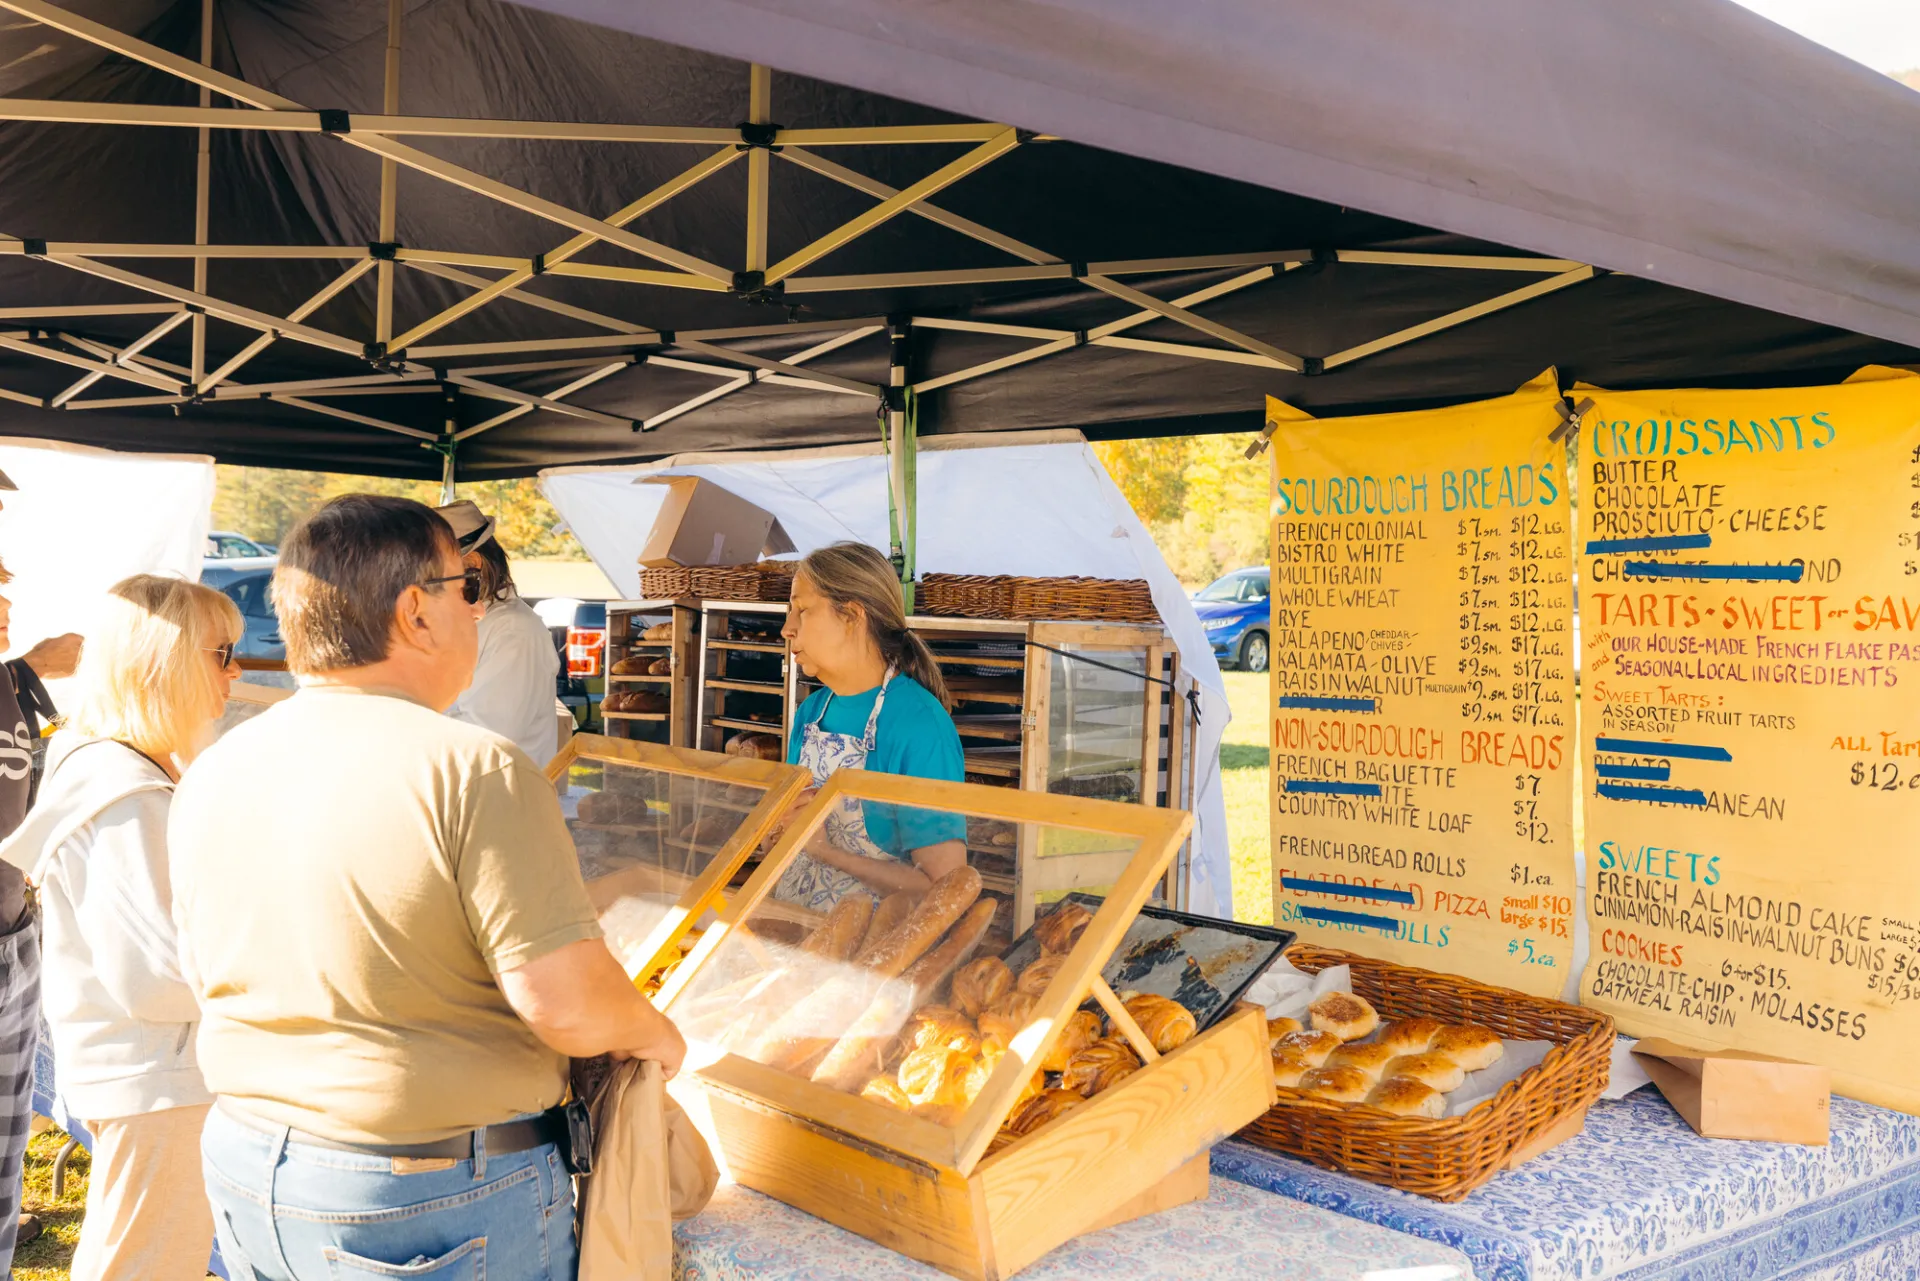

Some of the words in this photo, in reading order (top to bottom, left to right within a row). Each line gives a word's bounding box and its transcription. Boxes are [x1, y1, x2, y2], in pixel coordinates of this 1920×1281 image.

[1593, 412, 1836, 457] CROISSANTS
[1592, 460, 1678, 485] BUTTER
[1276, 473, 1428, 516] SOURDOUGH
[1441, 462, 1558, 512] BREADS
[1594, 484, 1726, 509] CHOCOLATE
[1278, 522, 1341, 542] FRENCH
[1346, 520, 1428, 541] COLONIAL
[1278, 543, 1337, 563] BISTRO
[1346, 543, 1405, 563] WHITE
[1278, 565, 1382, 585] MULTIGRAIN
[1279, 587, 1336, 607] WHOLE
[1339, 588, 1401, 608] WHEAT
[1278, 609, 1312, 628] RYE
[1591, 593, 1701, 628] TARTS
[1722, 595, 1828, 631] SWEET
[1587, 629, 1611, 649] with
[1611, 636, 1642, 653] OUR
[1647, 633, 1748, 656] HOUSE-MADE
[1756, 635, 1819, 659] FRENCH
[1825, 641, 1884, 661] FLAKE
[1278, 650, 1367, 672] KALAMATA
[1381, 655, 1437, 676] OLIVE
[1591, 651, 1610, 672] and
[1614, 654, 1695, 679] SEASONAL
[1697, 657, 1748, 682] LOCAL
[1752, 663, 1898, 688] INGREDIENTS
[1278, 670, 1341, 691] RAISIN
[1345, 673, 1426, 696] WALNUT
[1424, 684, 1467, 694] MULTIGRAIN
[1593, 680, 1653, 704] SWEET
[1602, 704, 1691, 723] ASSORTED
[1697, 710, 1743, 726] FRUIT
[1749, 713, 1796, 730] TARTS
[1603, 717, 1615, 729] IN
[1620, 719, 1675, 733] SEASON
[1275, 718, 1444, 761] NON-SOURDOUGH
[1461, 730, 1564, 770] BREADS
[1830, 736, 1872, 752] ALL
[1277, 754, 1347, 778] FRENCH
[1355, 760, 1457, 788] BAGUETTE
[1278, 794, 1359, 821] COUNTRY
[1363, 802, 1420, 828] WHITE
[1428, 810, 1472, 834] LOAF
[1515, 821, 1554, 844] $12.
[1280, 835, 1344, 861] FRENCH
[1348, 843, 1407, 869] BREAD
[1412, 851, 1466, 878] ROLLS
[1598, 841, 1720, 886] SWEETS
[1434, 890, 1491, 920] PIZZA
[1502, 894, 1539, 910] small
[1597, 870, 1678, 907] FRENCH
[1690, 888, 1802, 927] ALMOND
[1810, 908, 1872, 941] CAKE
[1881, 917, 1914, 931] SMALL
[1500, 907, 1535, 930] large
[1601, 928, 1684, 968] COOKIES
[1880, 931, 1908, 945] LARGE
[1721, 958, 1732, 978] 6
[1829, 938, 1887, 972] BUNS
[1592, 978, 1672, 1012] OATMEAL
[1678, 997, 1737, 1028] RAISIN
[1751, 990, 1867, 1041] MOLASSES
